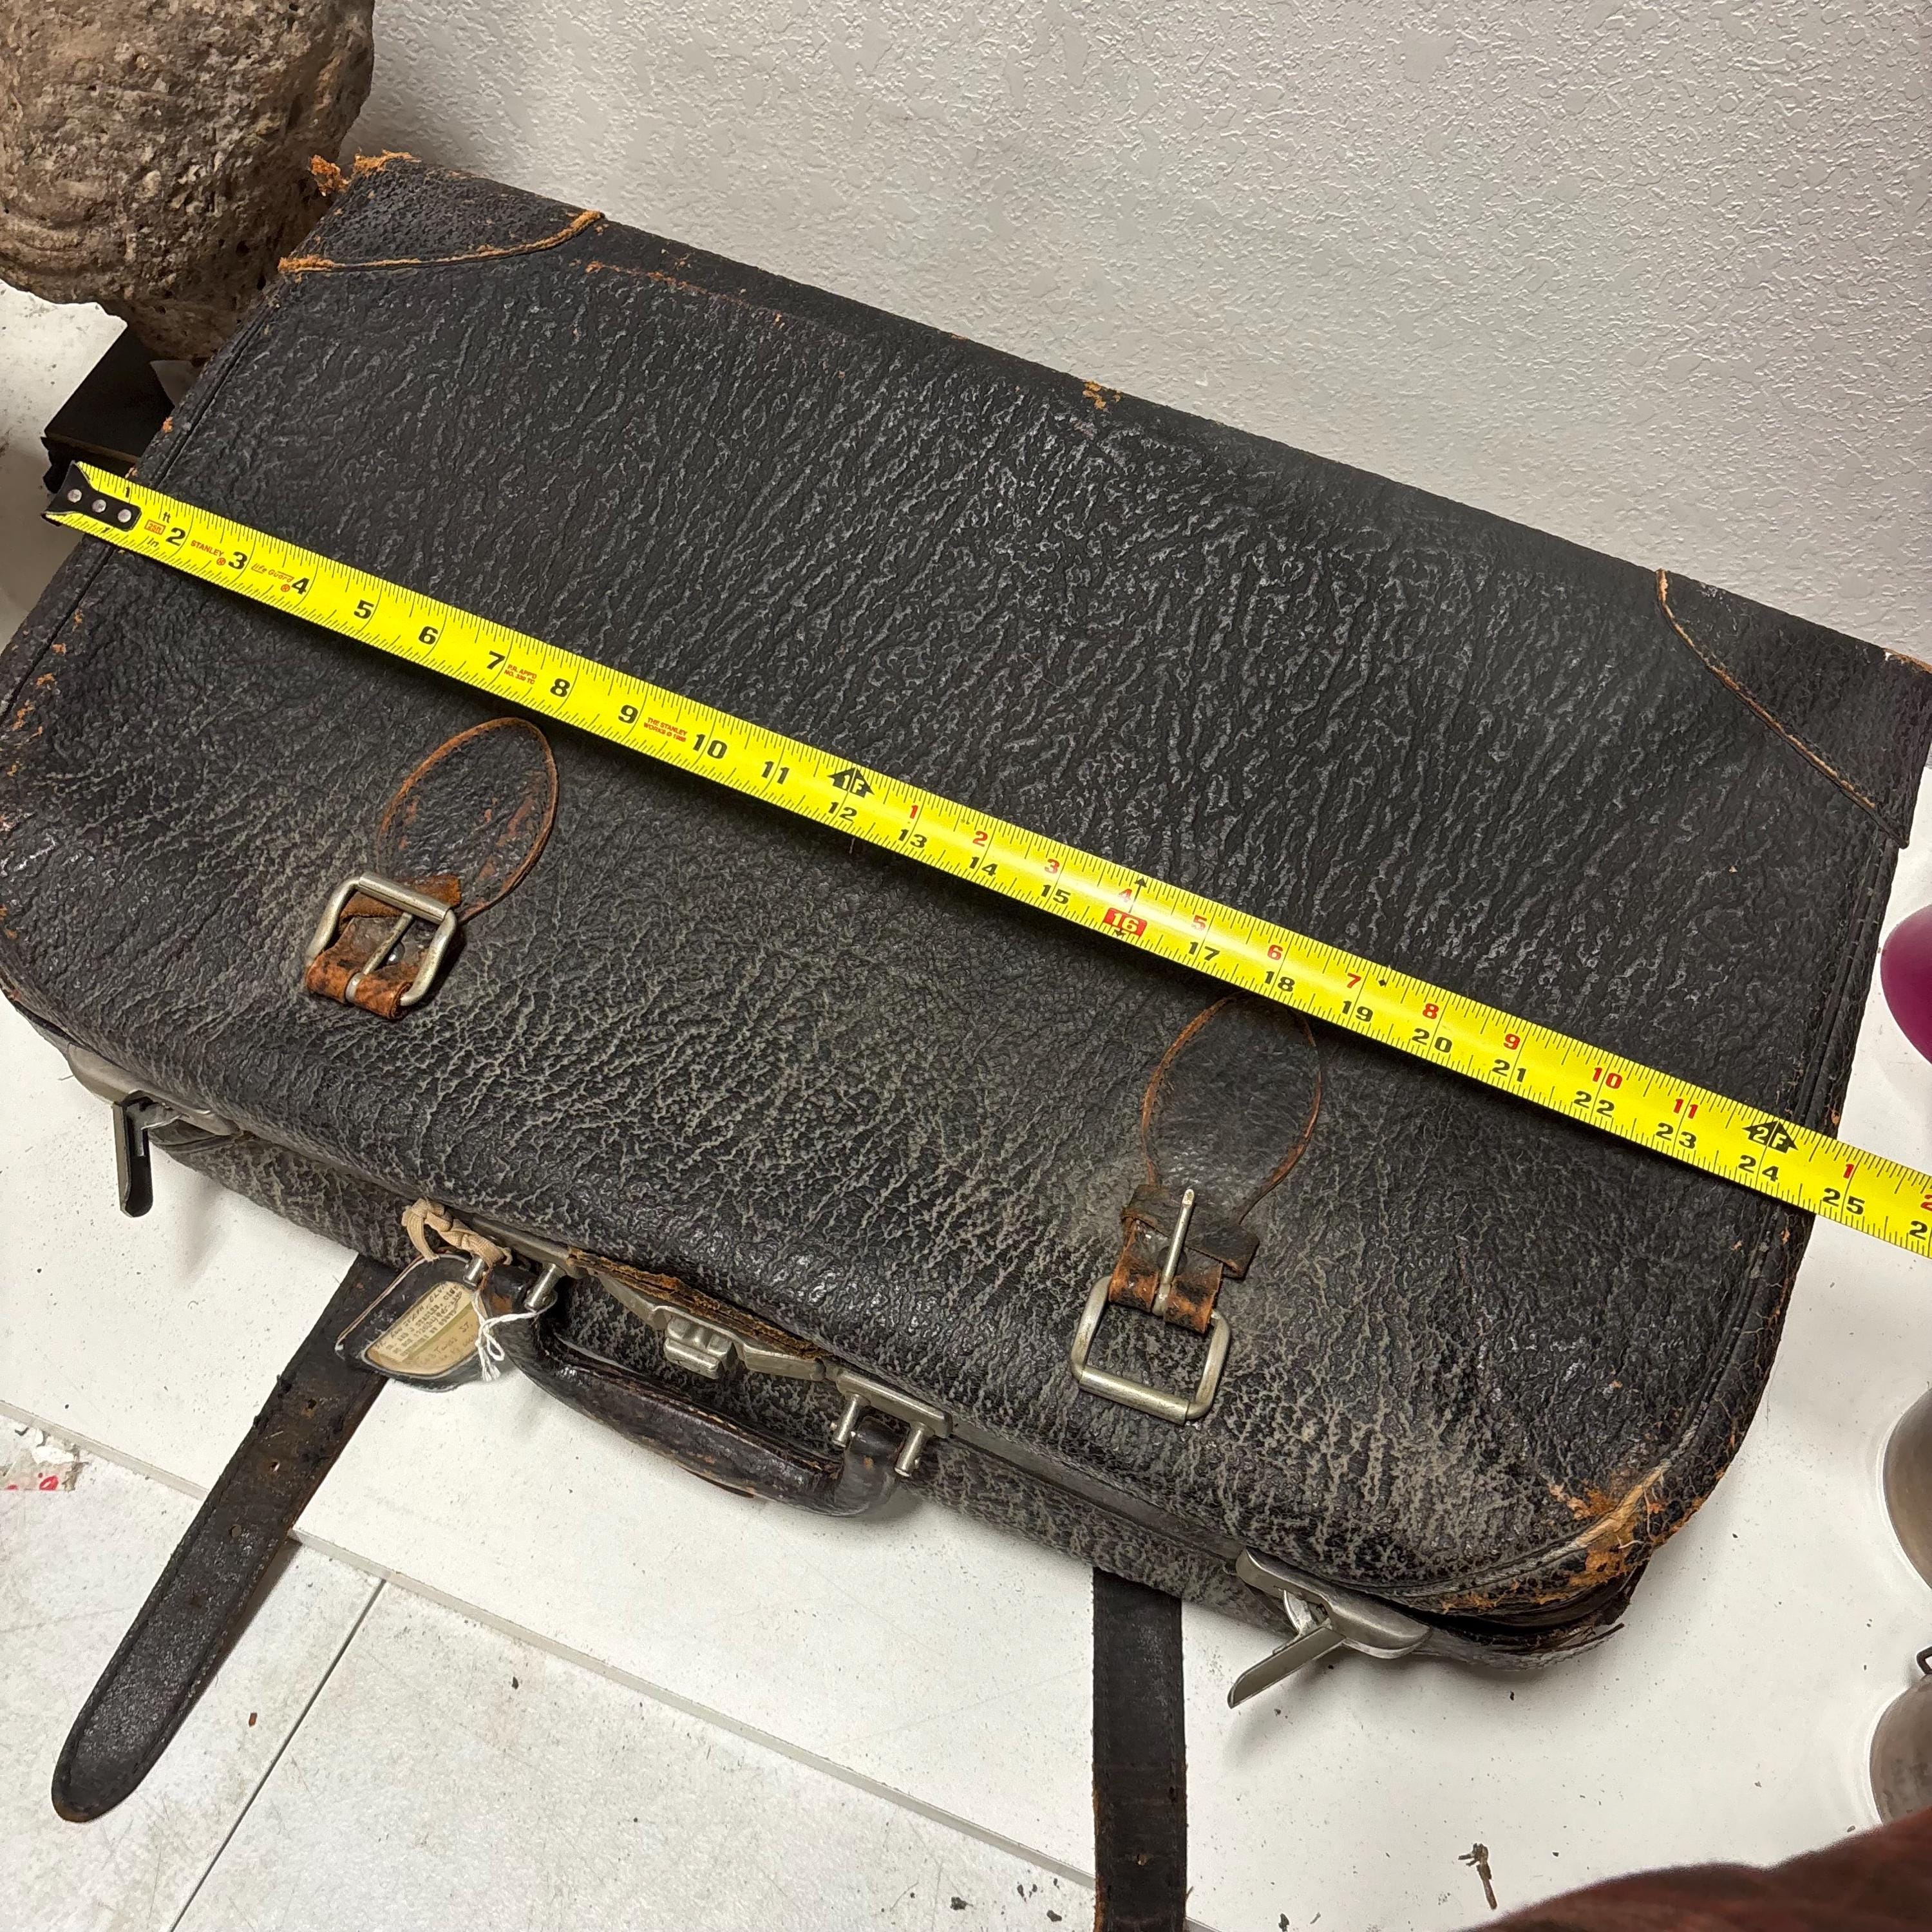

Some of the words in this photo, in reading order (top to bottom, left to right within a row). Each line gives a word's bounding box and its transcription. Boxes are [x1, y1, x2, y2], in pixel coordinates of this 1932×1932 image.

[126, 487, 130, 498] 1
[163, 511, 171, 524] ft
[166, 527, 185, 546] 2
[191, 540, 224, 556] STANLEY
[228, 552, 247, 569] 3
[291, 577, 310, 595] 4
[354, 600, 374, 619] 5
[419, 626, 439, 645] 6
[486, 650, 506, 670] 7
[550, 678, 570, 697] 8
[618, 705, 638, 724] 9
[648, 717, 660, 726] THE
[660, 722, 688, 736] STANLEY
[692, 734, 727, 759] 10
[761, 761, 790, 784] 11
[828, 801, 857, 822] 12
[909, 805, 918, 819] 1
[897, 829, 927, 849] 13
[972, 831, 989, 847] 2
[968, 857, 998, 876] 14
[1045, 858, 1060, 874] 3
[1041, 884, 1071, 905] 15
[1118, 888, 1133, 903] 4
[1111, 911, 1139, 933] 16
[1191, 914, 1207, 931] 5
[1188, 942, 1220, 961] 17
[1267, 944, 1283, 960] 6
[1264, 971, 1295, 992] 18
[1347, 972, 1361, 989] 7
[1341, 1001, 1374, 1022] 19
[1423, 1003, 1439, 1019] 8
[1411, 1028, 1453, 1053] 20
[1503, 1033, 1520, 1050] 9
[1492, 1059, 1527, 1083] 21
[1592, 1067, 1623, 1089] 10
[1574, 1090, 1615, 1118] 22
[1673, 1098, 1699, 1119] 11
[1656, 1122, 1697, 1150] 23
[1738, 1155, 1779, 1182] 24
[1843, 1164, 1854, 1179] 1
[1822, 1187, 1866, 1215] 25
